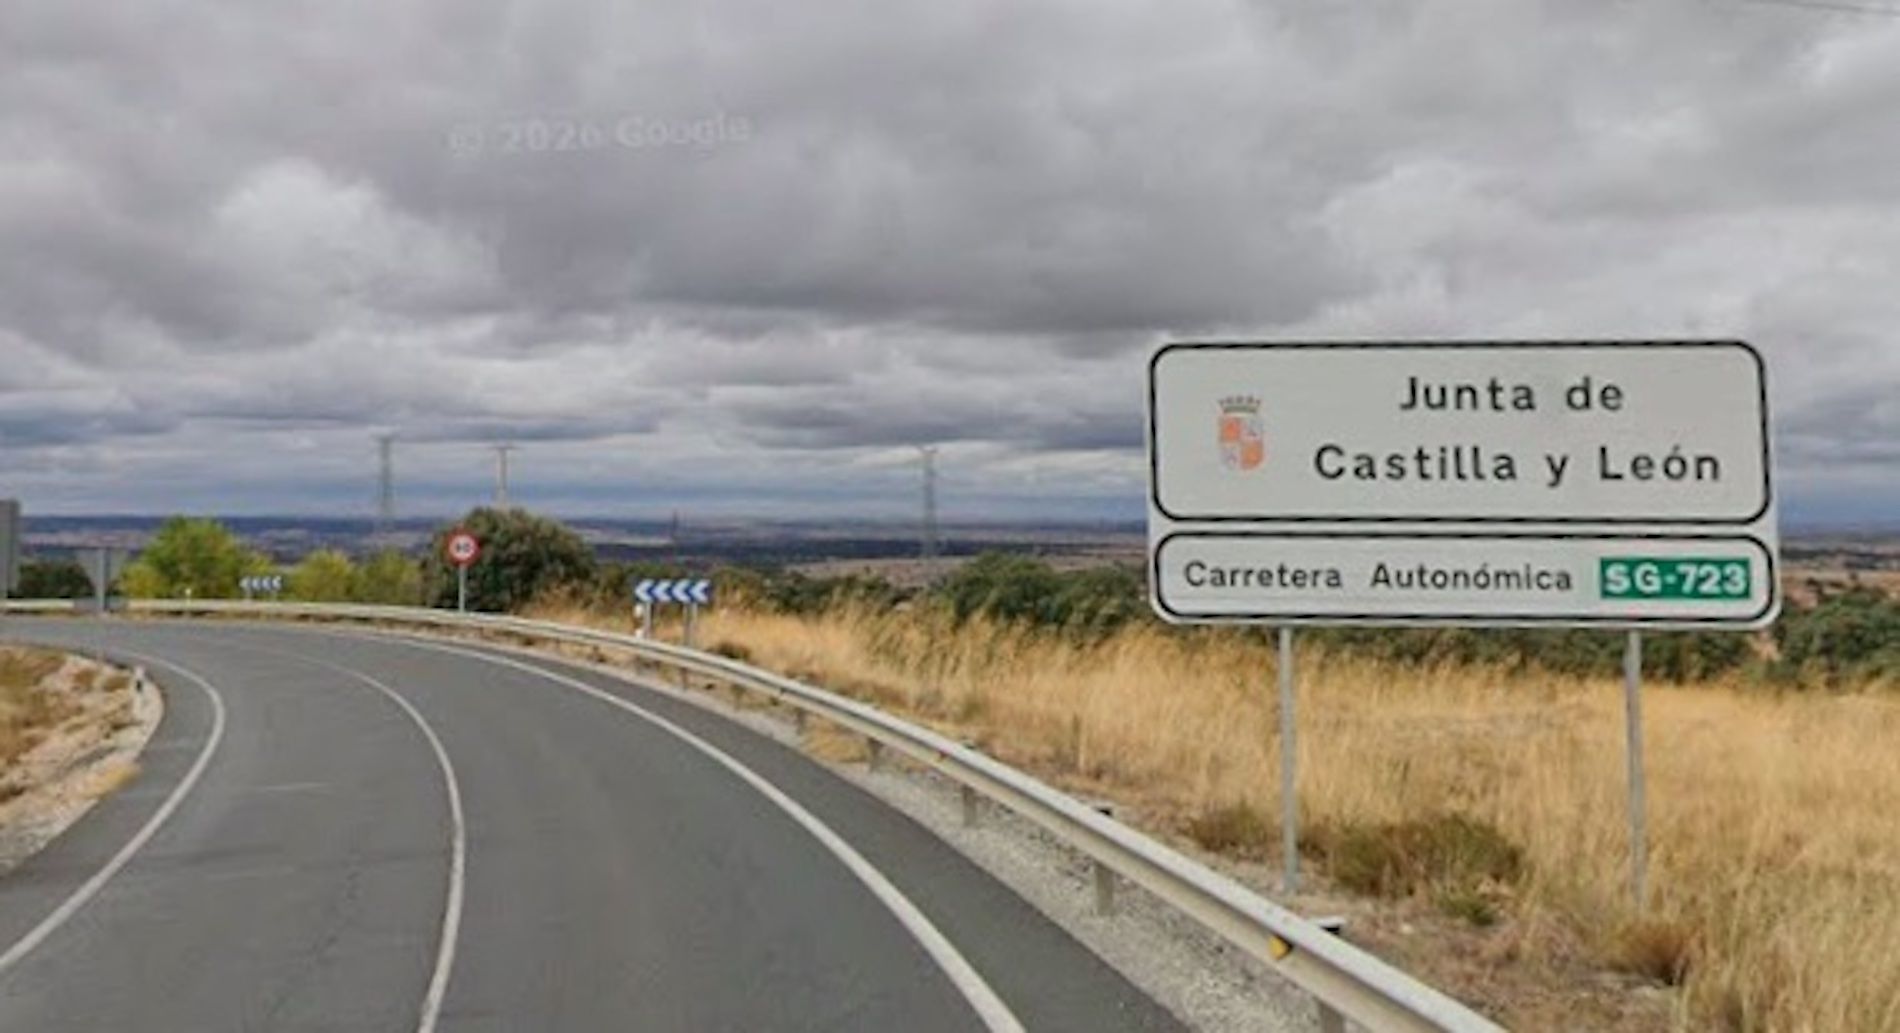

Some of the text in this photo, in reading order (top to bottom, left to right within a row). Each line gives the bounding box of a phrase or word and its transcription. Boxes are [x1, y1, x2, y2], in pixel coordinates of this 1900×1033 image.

[1400, 376, 1623, 411] Junta de
[1314, 443, 1721, 487] Castilla y León
[1183, 559, 1747, 594] Carretera Autonómica SG-723
